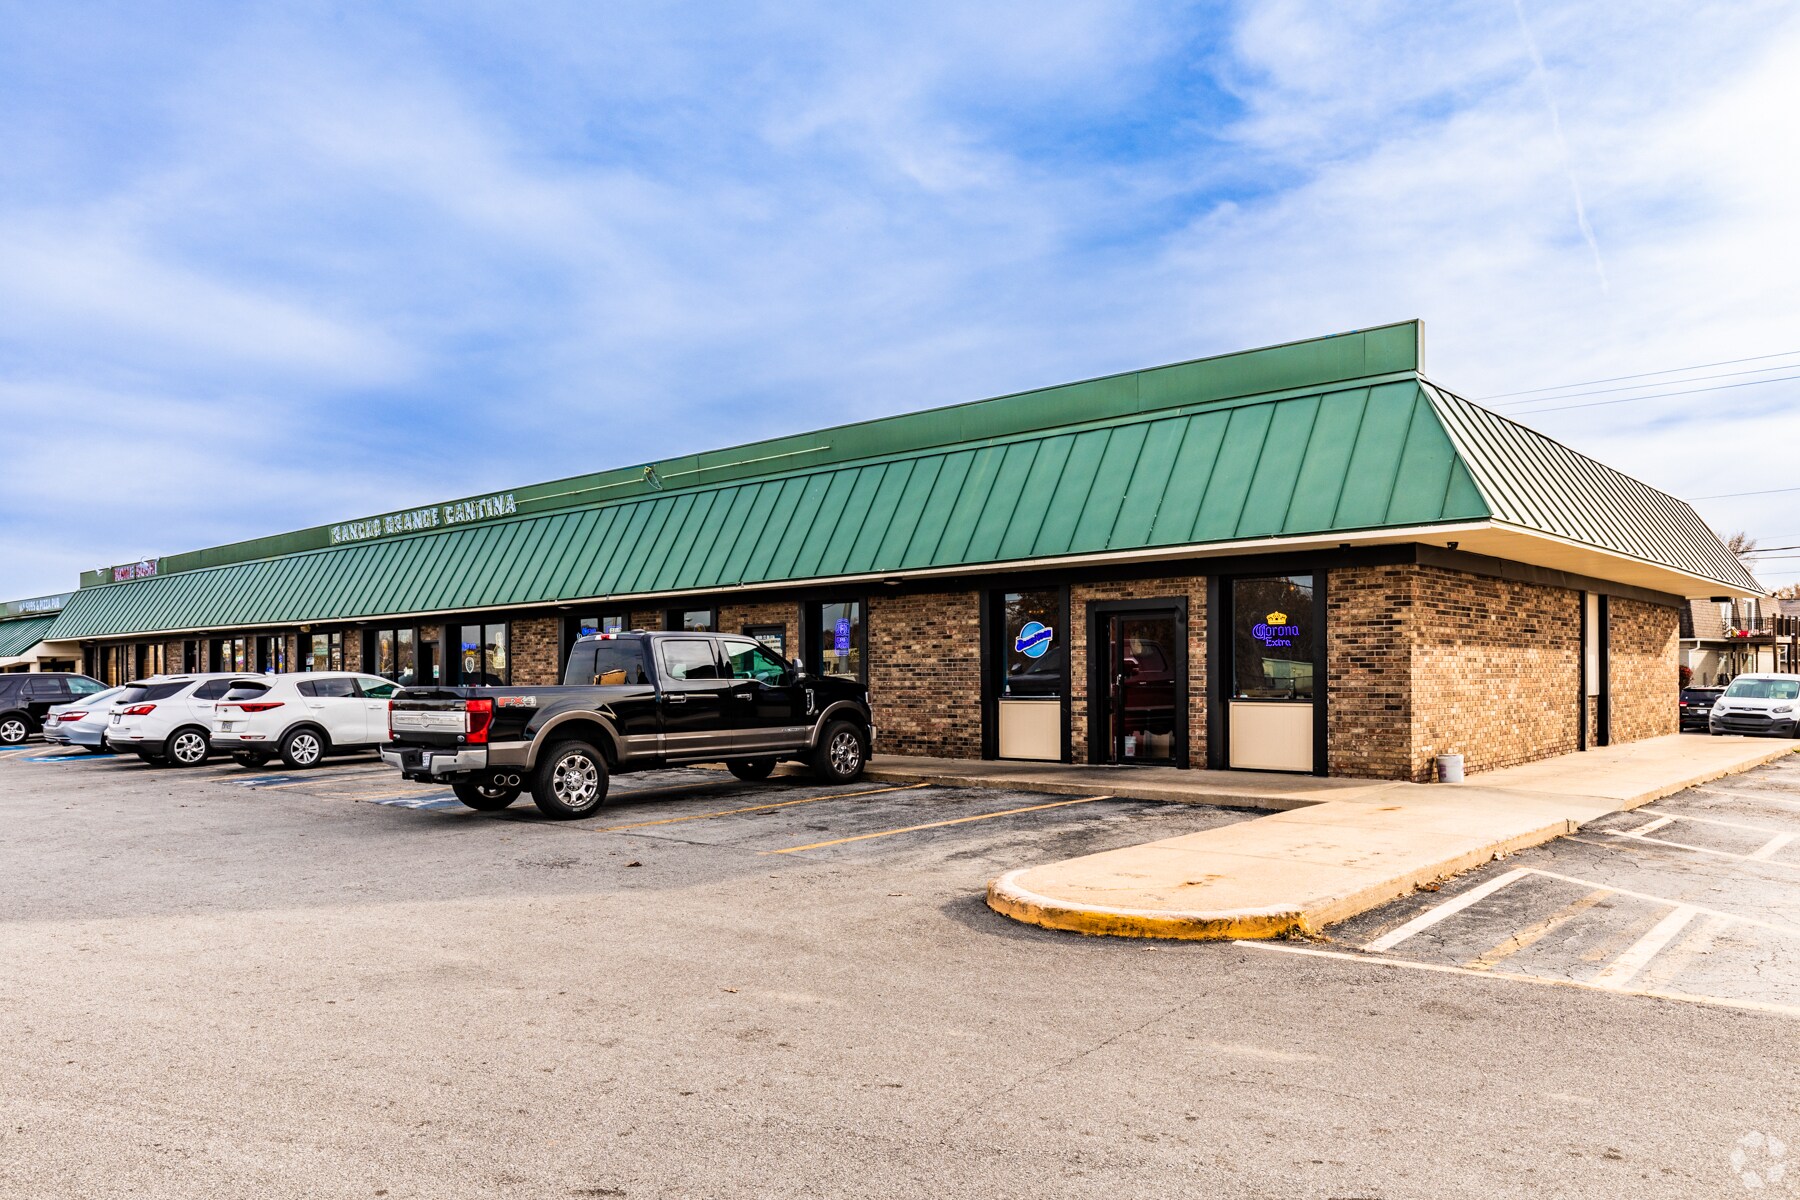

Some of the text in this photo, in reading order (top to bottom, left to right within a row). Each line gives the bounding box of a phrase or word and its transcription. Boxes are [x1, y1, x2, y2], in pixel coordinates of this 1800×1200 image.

[331, 494, 517, 544] RANCHO GRANDE CANTINA
[1252, 623, 1300, 640] Corona
[1265, 637, 1292, 647] Extra
[498, 696, 536, 707] FX4
